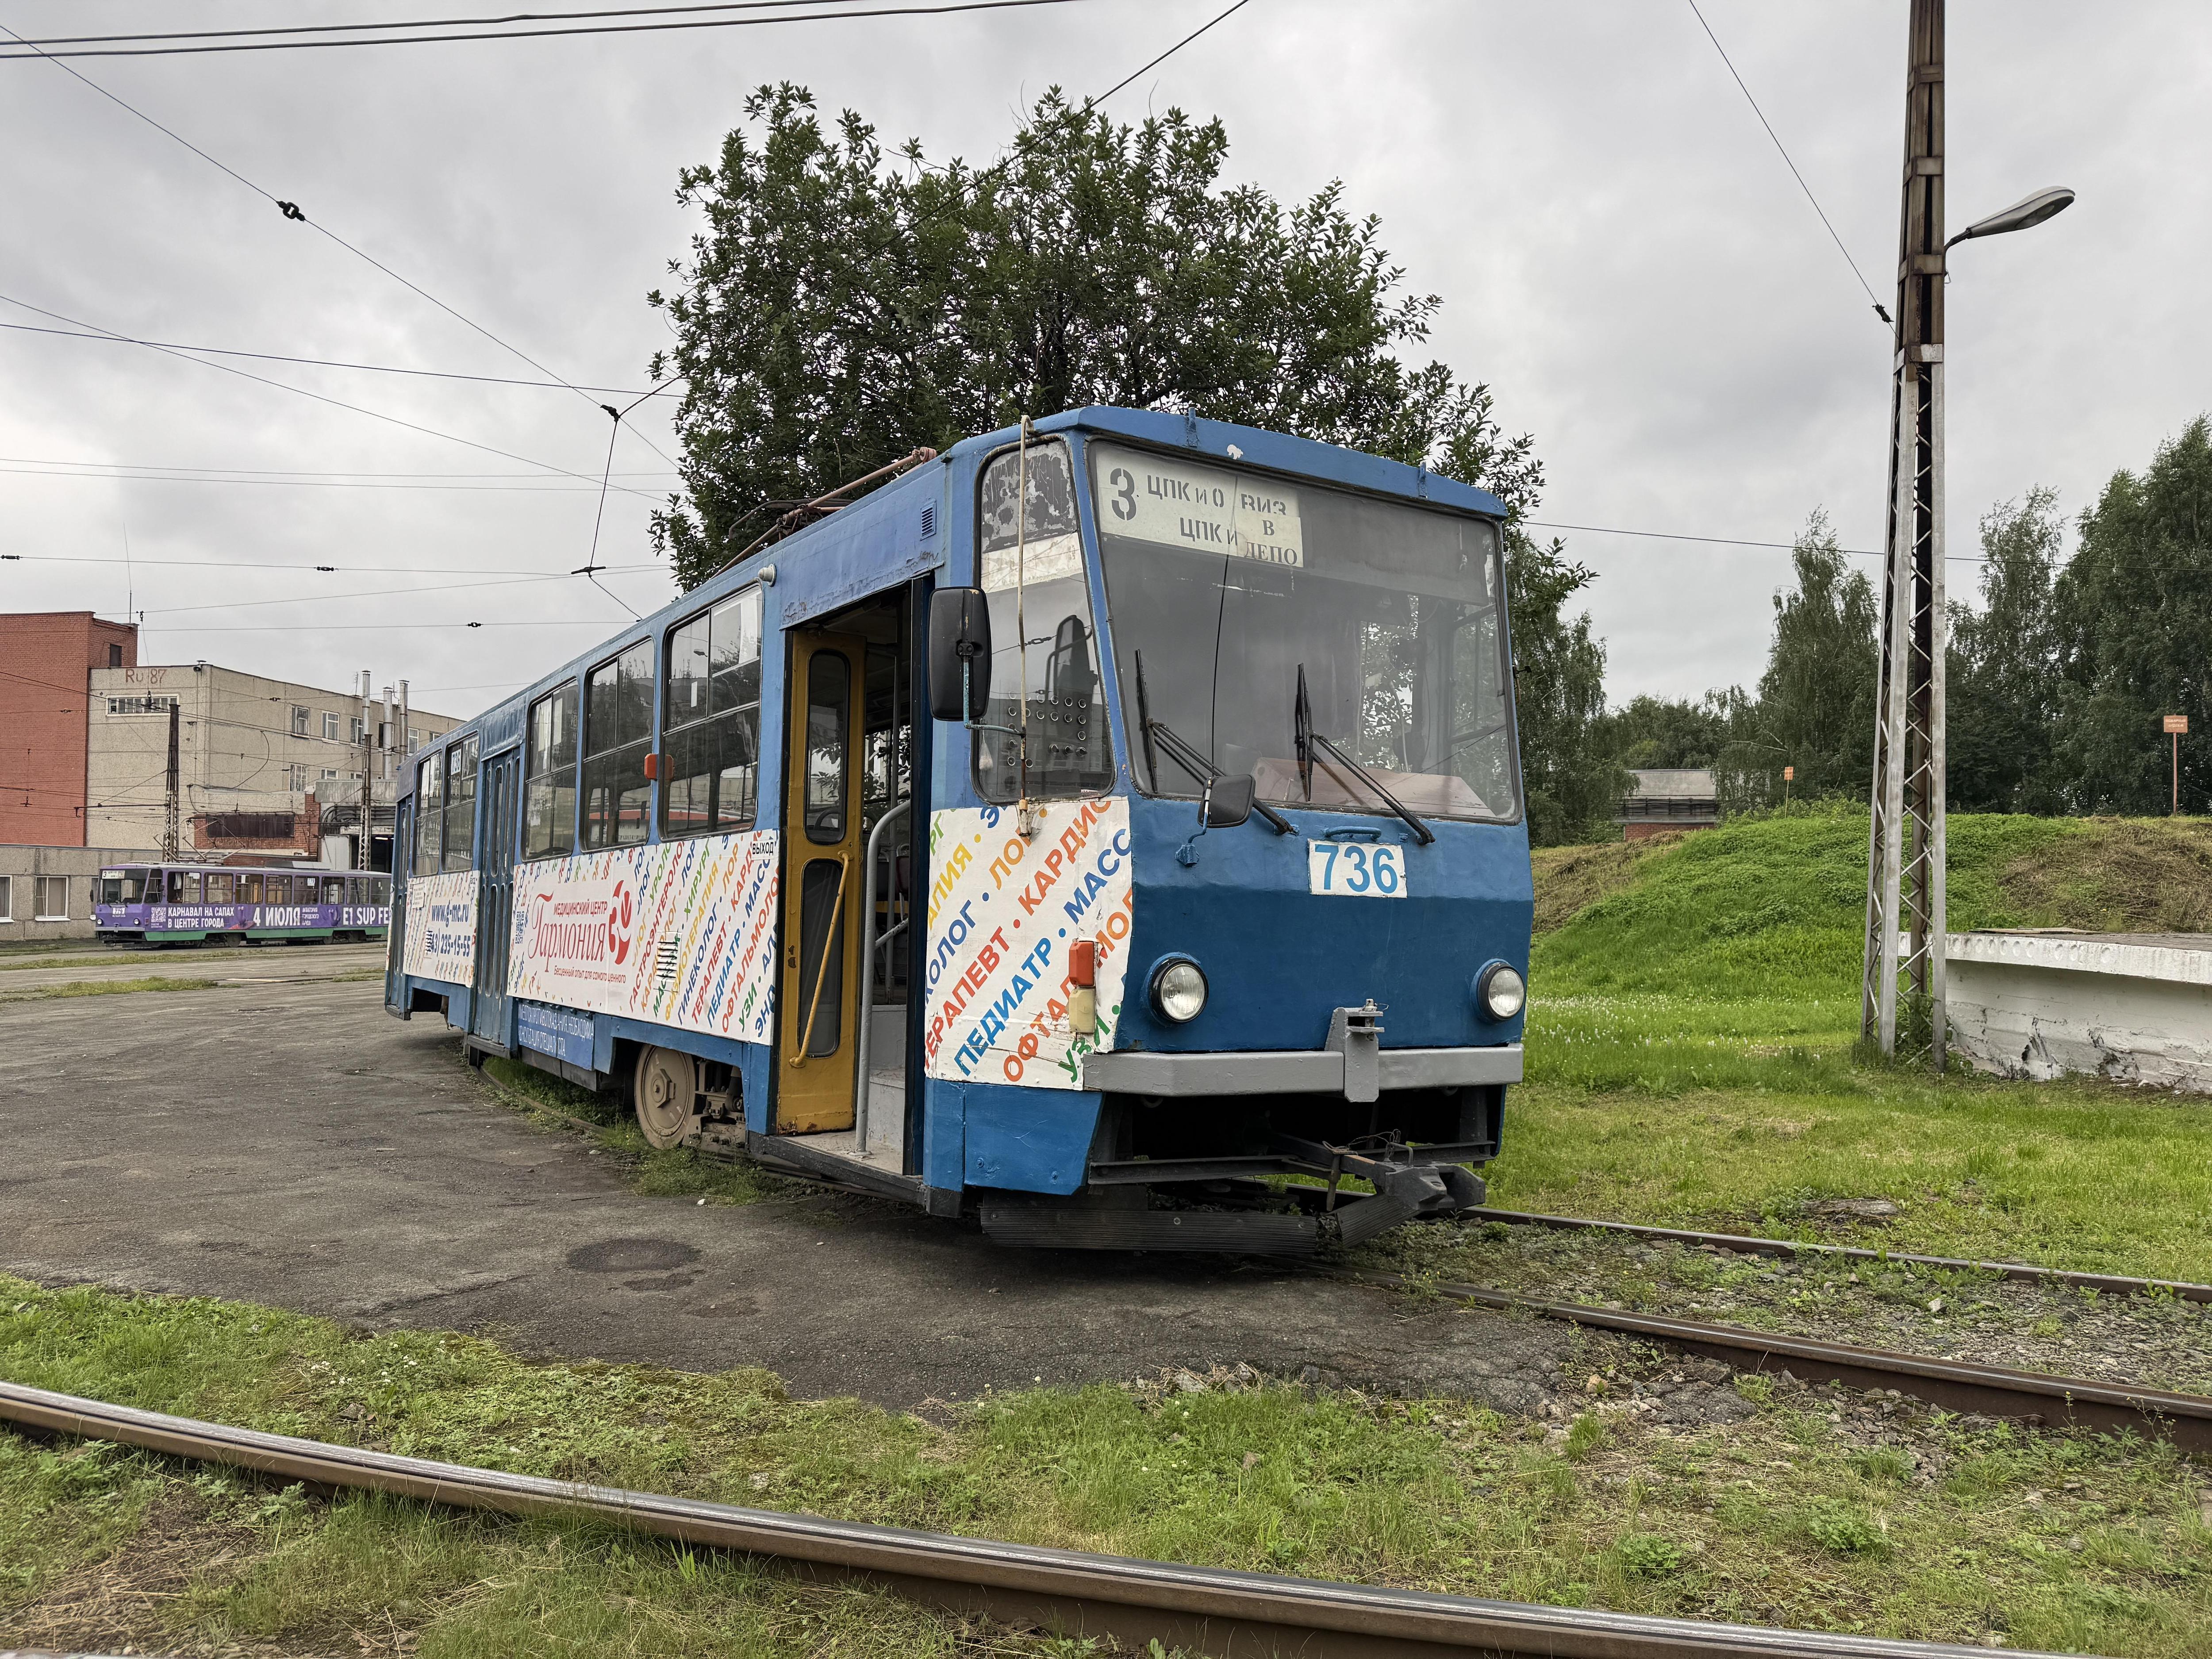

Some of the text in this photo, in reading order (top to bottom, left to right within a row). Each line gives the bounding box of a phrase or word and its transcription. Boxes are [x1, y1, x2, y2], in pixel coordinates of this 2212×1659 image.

[1110, 468, 1137, 520] 3
[1263, 520, 1275, 536] В
[1244, 542, 1298, 565] ДЕПО
[150, 668, 167, 684] 87
[980, 806, 1007, 829] Э
[681, 840, 695, 887] ЛОР
[722, 842, 738, 894] ЛОР
[753, 842, 774, 856] ВЫХОД
[1315, 844, 1398, 894] 736
[684, 838, 710, 922] ХИРУРГ
[1064, 829, 1132, 925] МАСС
[168, 907, 234, 917] КАРНАВАЛ НА САПАХ
[168, 919, 172, 928] В
[174, 918, 199, 929] ЦЕНТРЕ
[201, 918, 224, 928] ГОРОДА
[253, 907, 300, 926] 4 ИЮЛЯ
[343, 907, 390, 926] E1 SUP FE
[432, 900, 469, 927] www.g-mc.ru
[528, 891, 606, 972] Гармония
[553, 899, 607, 917] МЕДИЦИНСКИЙ ЦЕНТР
[630, 841, 685, 1012] ГАСТРОЭНТЕРОЛО
[441, 933, 471, 957] 235-15-55
[678, 902, 717, 1025] ГИНЕКОЛОГ
[722, 868, 779, 1033] ОФТАЛЬМОЛО
[554, 965, 574, 977] Бесценный
[575, 969, 584, 977] опыт
[608, 974, 626, 983] ценного
[692, 921, 727, 1024] ТЕРАПЕВТ
[707, 928, 740, 1029] ПЕДИАТР
[738, 981, 757, 1033] УЗИ
[926, 926, 1010, 1070] ЕРАПЕВТ
[954, 937, 1051, 1076] ПЕДИАТР
